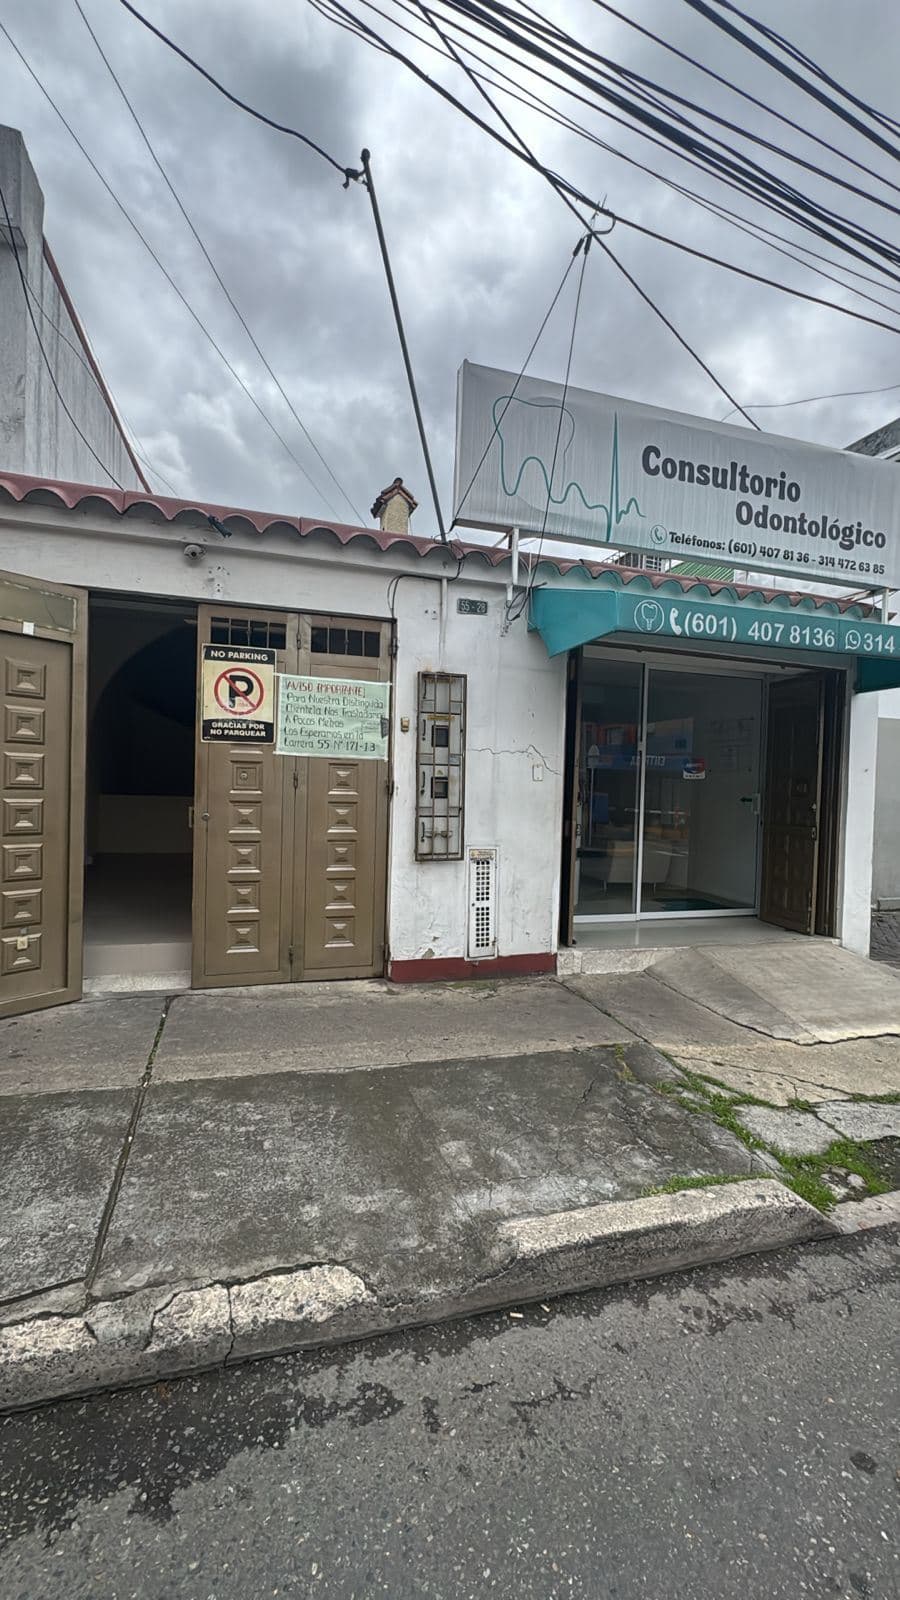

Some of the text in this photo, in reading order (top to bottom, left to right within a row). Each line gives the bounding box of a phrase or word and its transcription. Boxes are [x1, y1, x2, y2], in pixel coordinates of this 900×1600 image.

[641, 445, 801, 503] Consultorio
[735, 501, 887, 551] Odontológico
[669, 532, 726, 551] Teléfonos:
[728, 539, 757, 558] (601)
[759, 545, 781, 560] 407
[782, 550, 794, 562] 81
[796, 551, 810, 564] 36
[818, 554, 836, 568] 314
[837, 557, 857, 571] 472
[858, 561, 871, 573] 63
[872, 564, 885, 575] 85
[684, 611, 896, 653] (601) 407 8136 314
[210, 650, 269, 662] NO PARKING
[286, 692, 306, 704] Para
[308, 694, 340, 706] Nuestra
[285, 703, 322, 716] Clientela
[324, 706, 339, 716] Nos
[211, 721, 247, 729] GRACIAS
[285, 714, 345, 729] A Pocos Metros
[224, 729, 266, 737] PARQUEAR
[283, 726, 299, 736] Los
[300, 726, 342, 741] Esperamos
[284, 737, 314, 749] Carrera
[317, 740, 330, 750] 55
